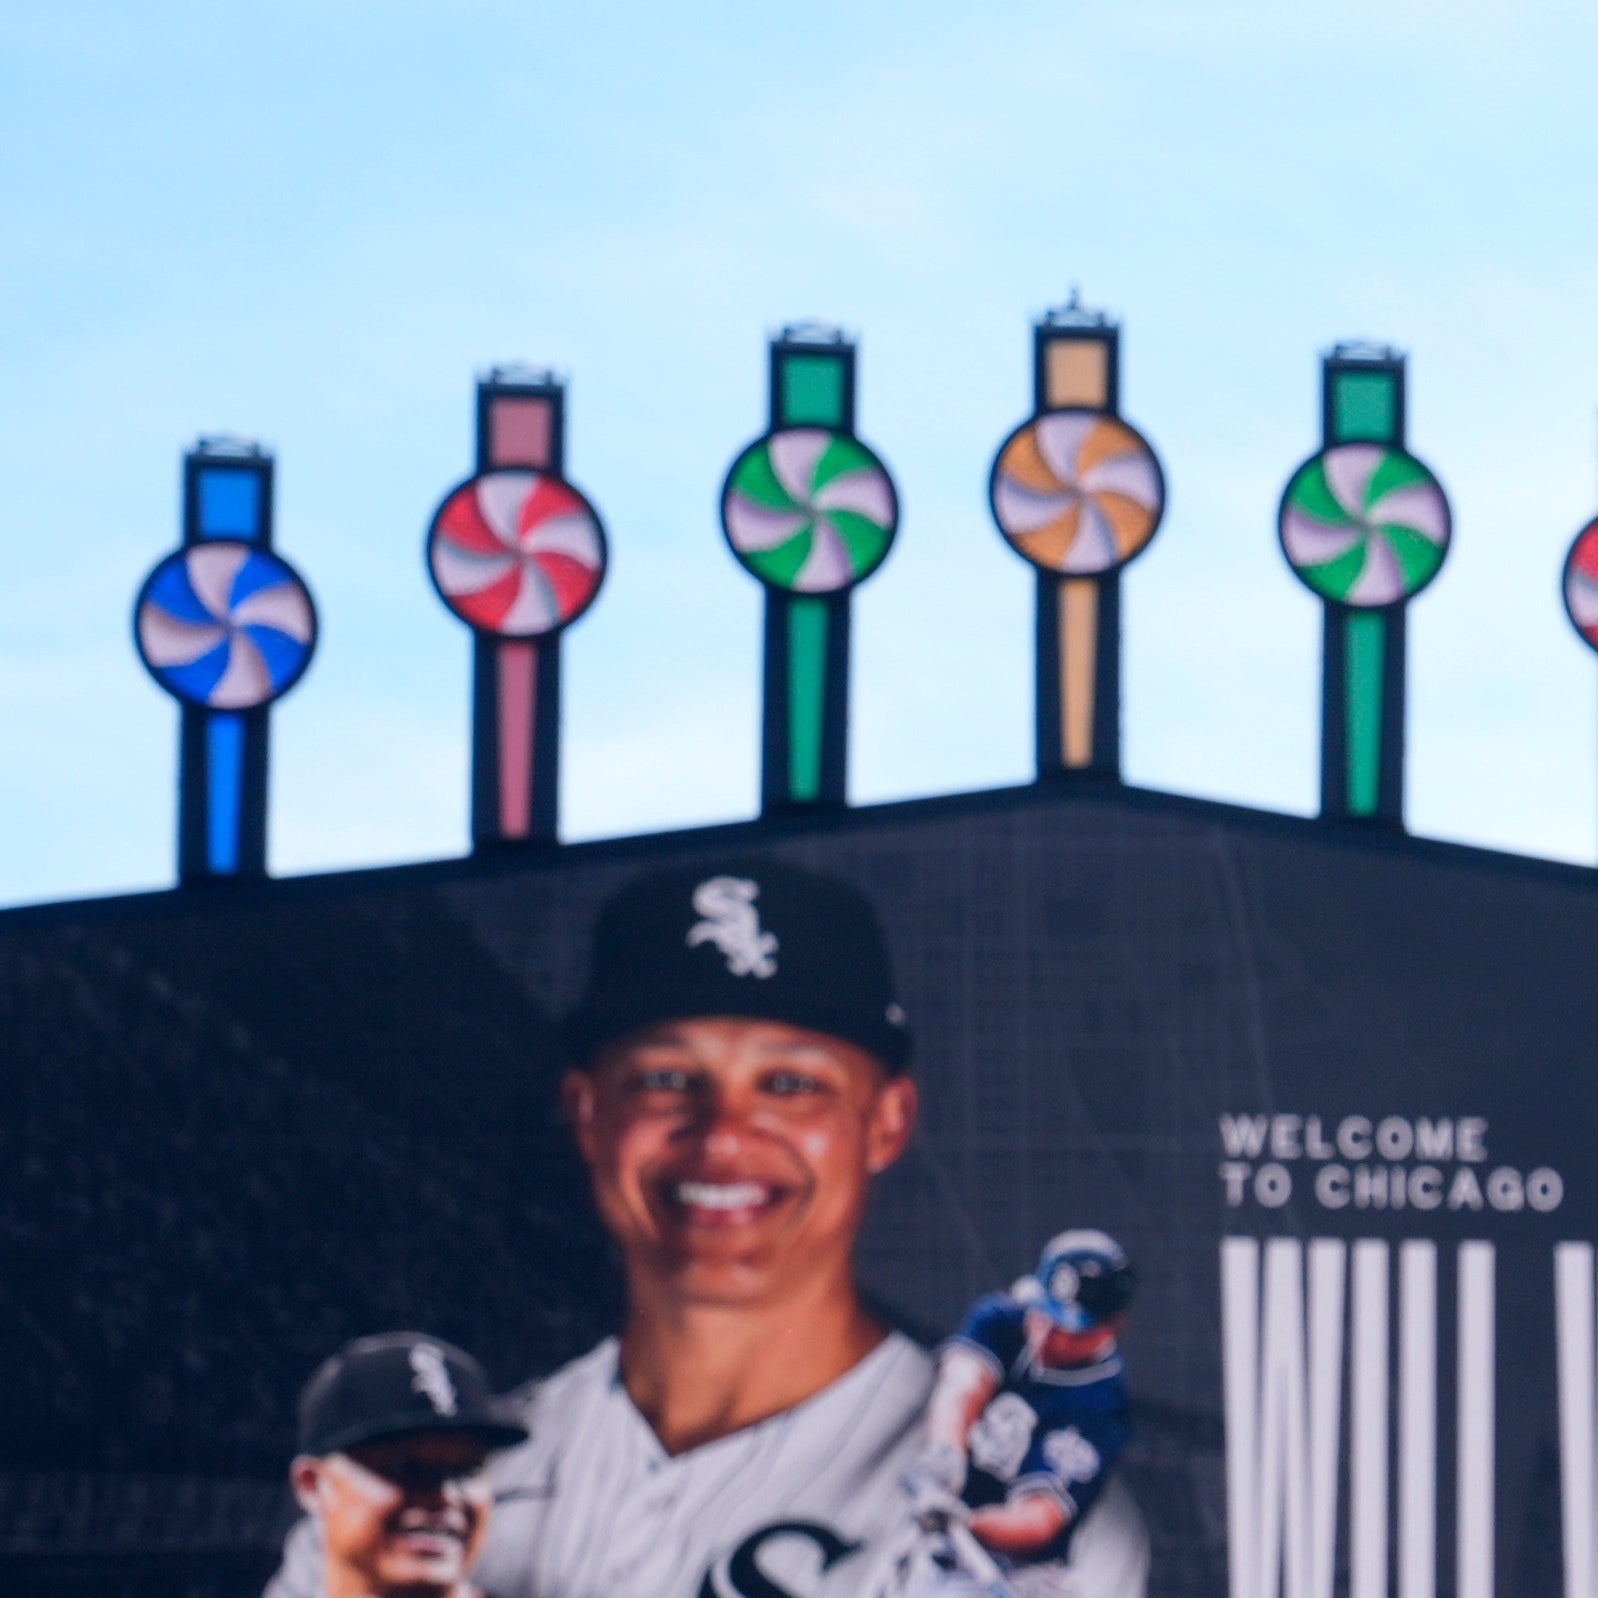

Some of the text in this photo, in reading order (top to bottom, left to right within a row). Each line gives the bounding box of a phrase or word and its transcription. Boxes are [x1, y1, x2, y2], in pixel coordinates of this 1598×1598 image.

[1219, 1113, 1489, 1163] WELCOME
[1219, 1165, 1564, 1212] TO CHICAGO
